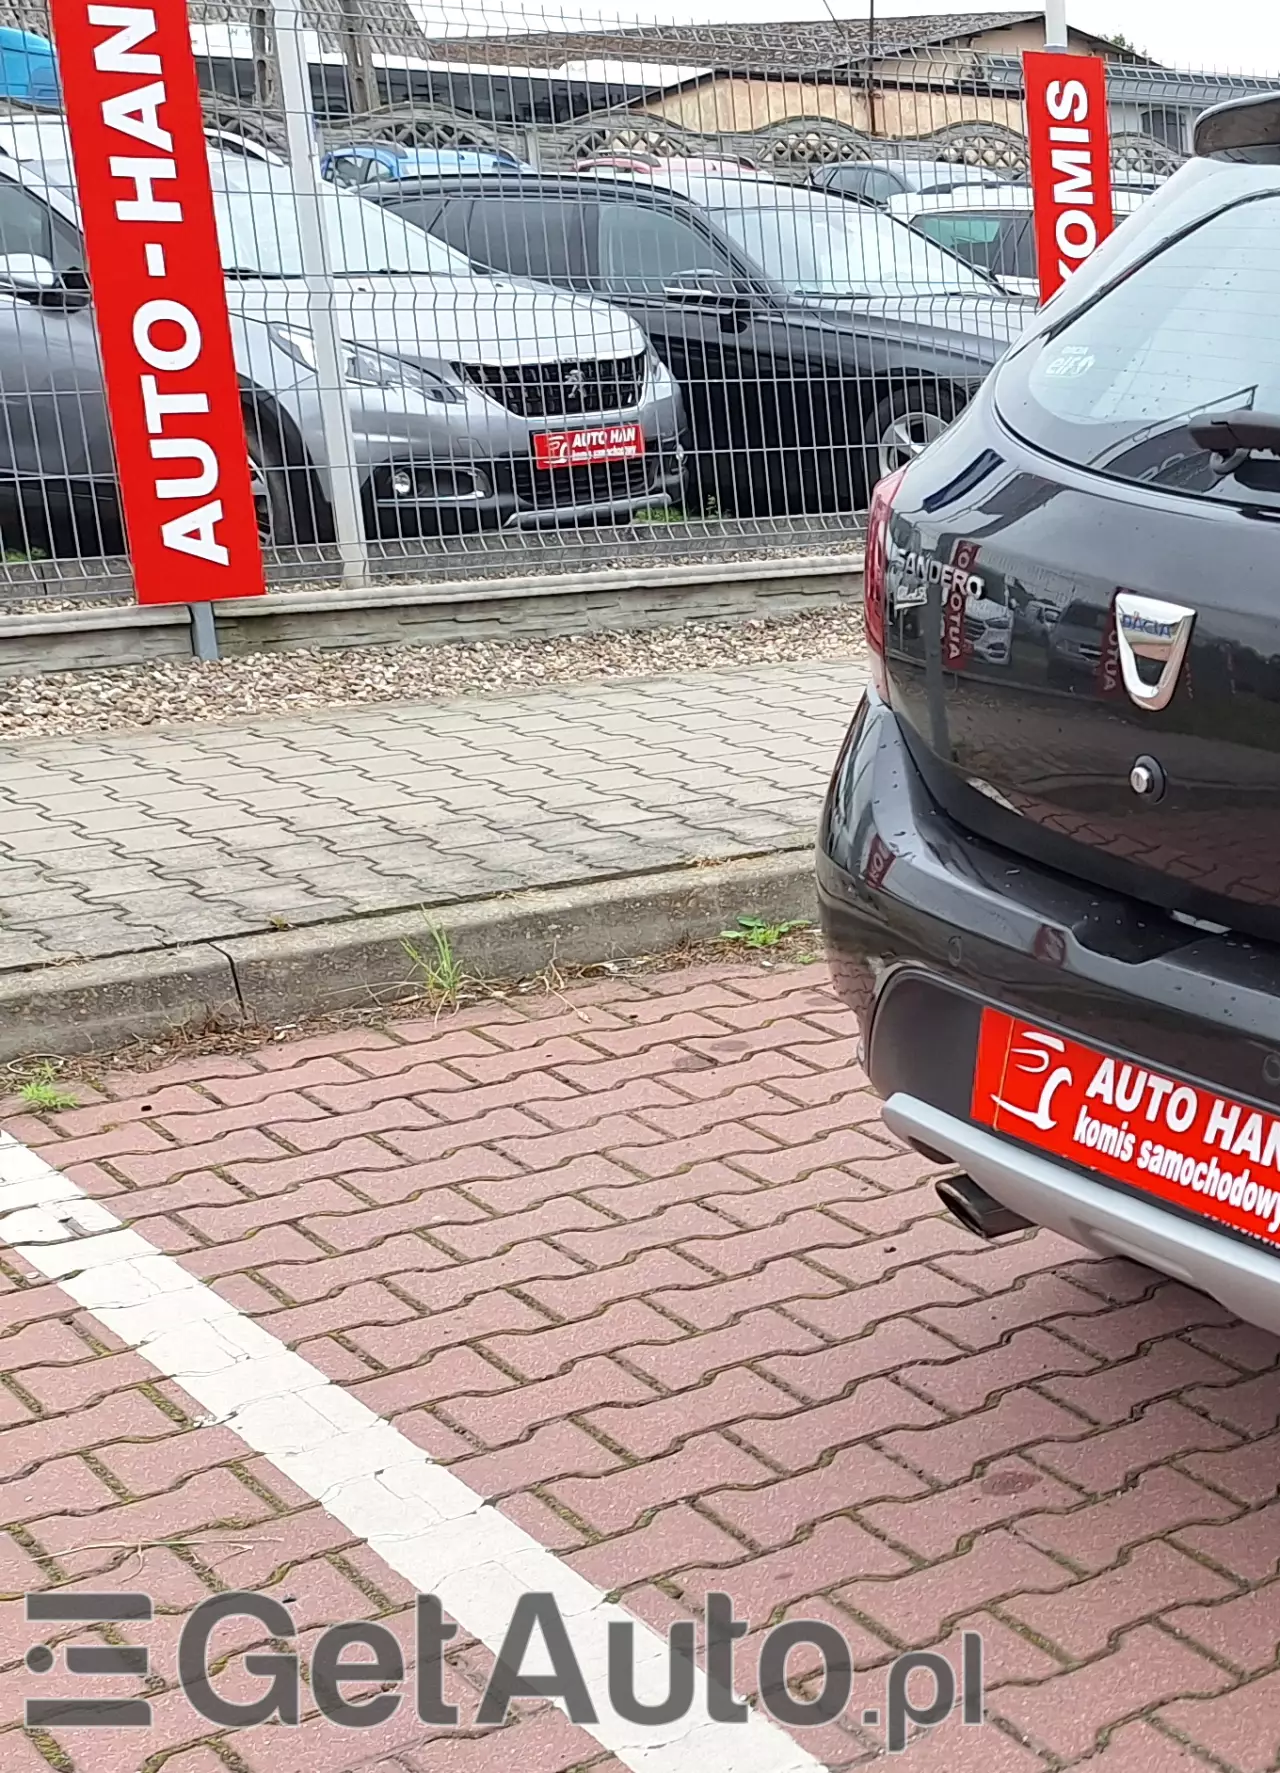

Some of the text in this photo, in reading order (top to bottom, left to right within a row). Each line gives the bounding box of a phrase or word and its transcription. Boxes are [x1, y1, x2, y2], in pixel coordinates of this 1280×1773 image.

[87, 4, 184, 222] HAN
[133, 299, 230, 566] AUTO
[572, 427, 636, 448] AUTO HAN
[893, 548, 985, 600] SANDERO
[1122, 614, 1171, 639] DACIA
[1085, 1057, 1198, 1133] AUTO
[1073, 1104, 1136, 1162] komis
